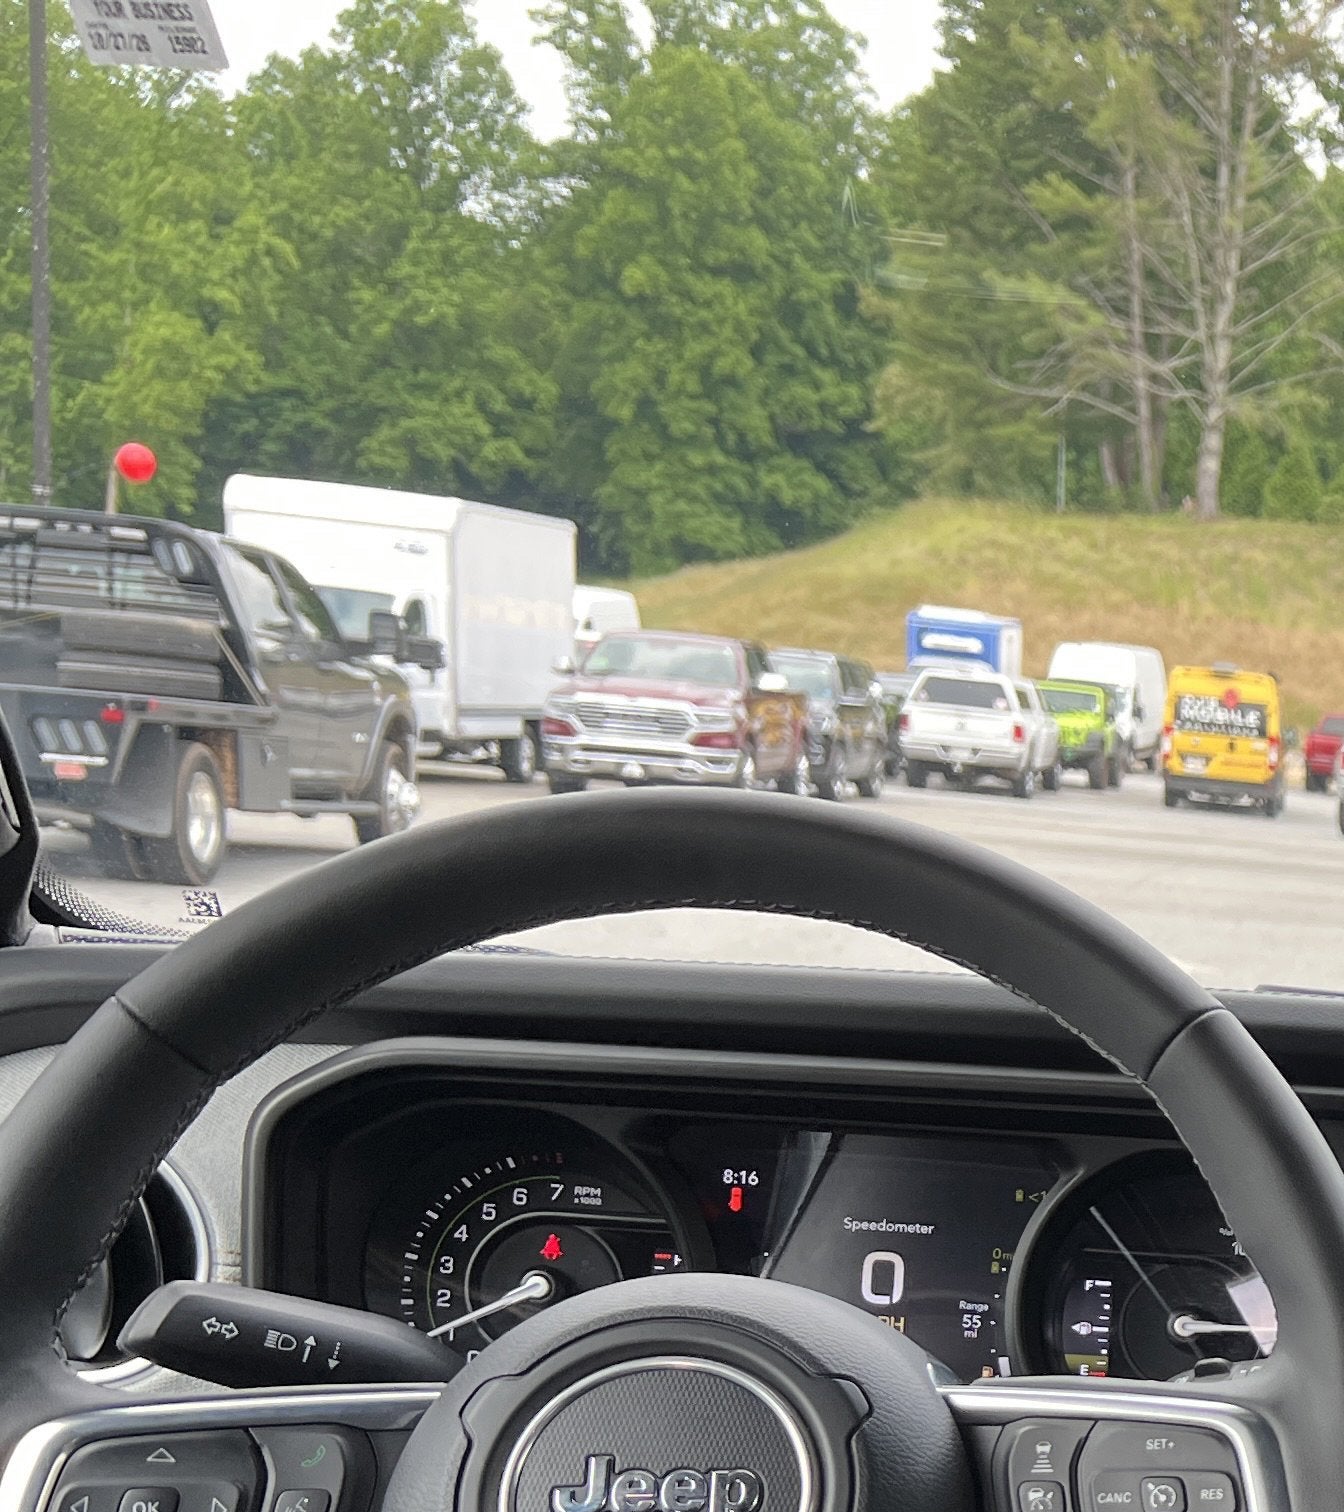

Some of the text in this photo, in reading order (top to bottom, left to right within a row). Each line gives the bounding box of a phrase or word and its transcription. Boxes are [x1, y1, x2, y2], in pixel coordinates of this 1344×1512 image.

[129, 1, 194, 22] BUSINESS
[722, 1168, 760, 1186] 8:16
[512, 1188, 528, 1206] 6
[550, 1183, 565, 1201] 7
[573, 1185, 601, 1197] RPM
[482, 1203, 497, 1221] 5
[453, 1224, 469, 1242] 4
[843, 1216, 935, 1235] Speedometer
[439, 1255, 455, 1275] 3
[861, 1250, 905, 1305] 0
[1085, 1279, 1095, 1291] F
[436, 1289, 451, 1308] 2
[958, 1300, 989, 1313] Range
[961, 1313, 982, 1330] 55
[963, 1329, 979, 1339] mi
[1080, 1363, 1090, 1376] E
[1097, 1491, 1133, 1504] CANC
[1200, 1488, 1224, 1501] RES
